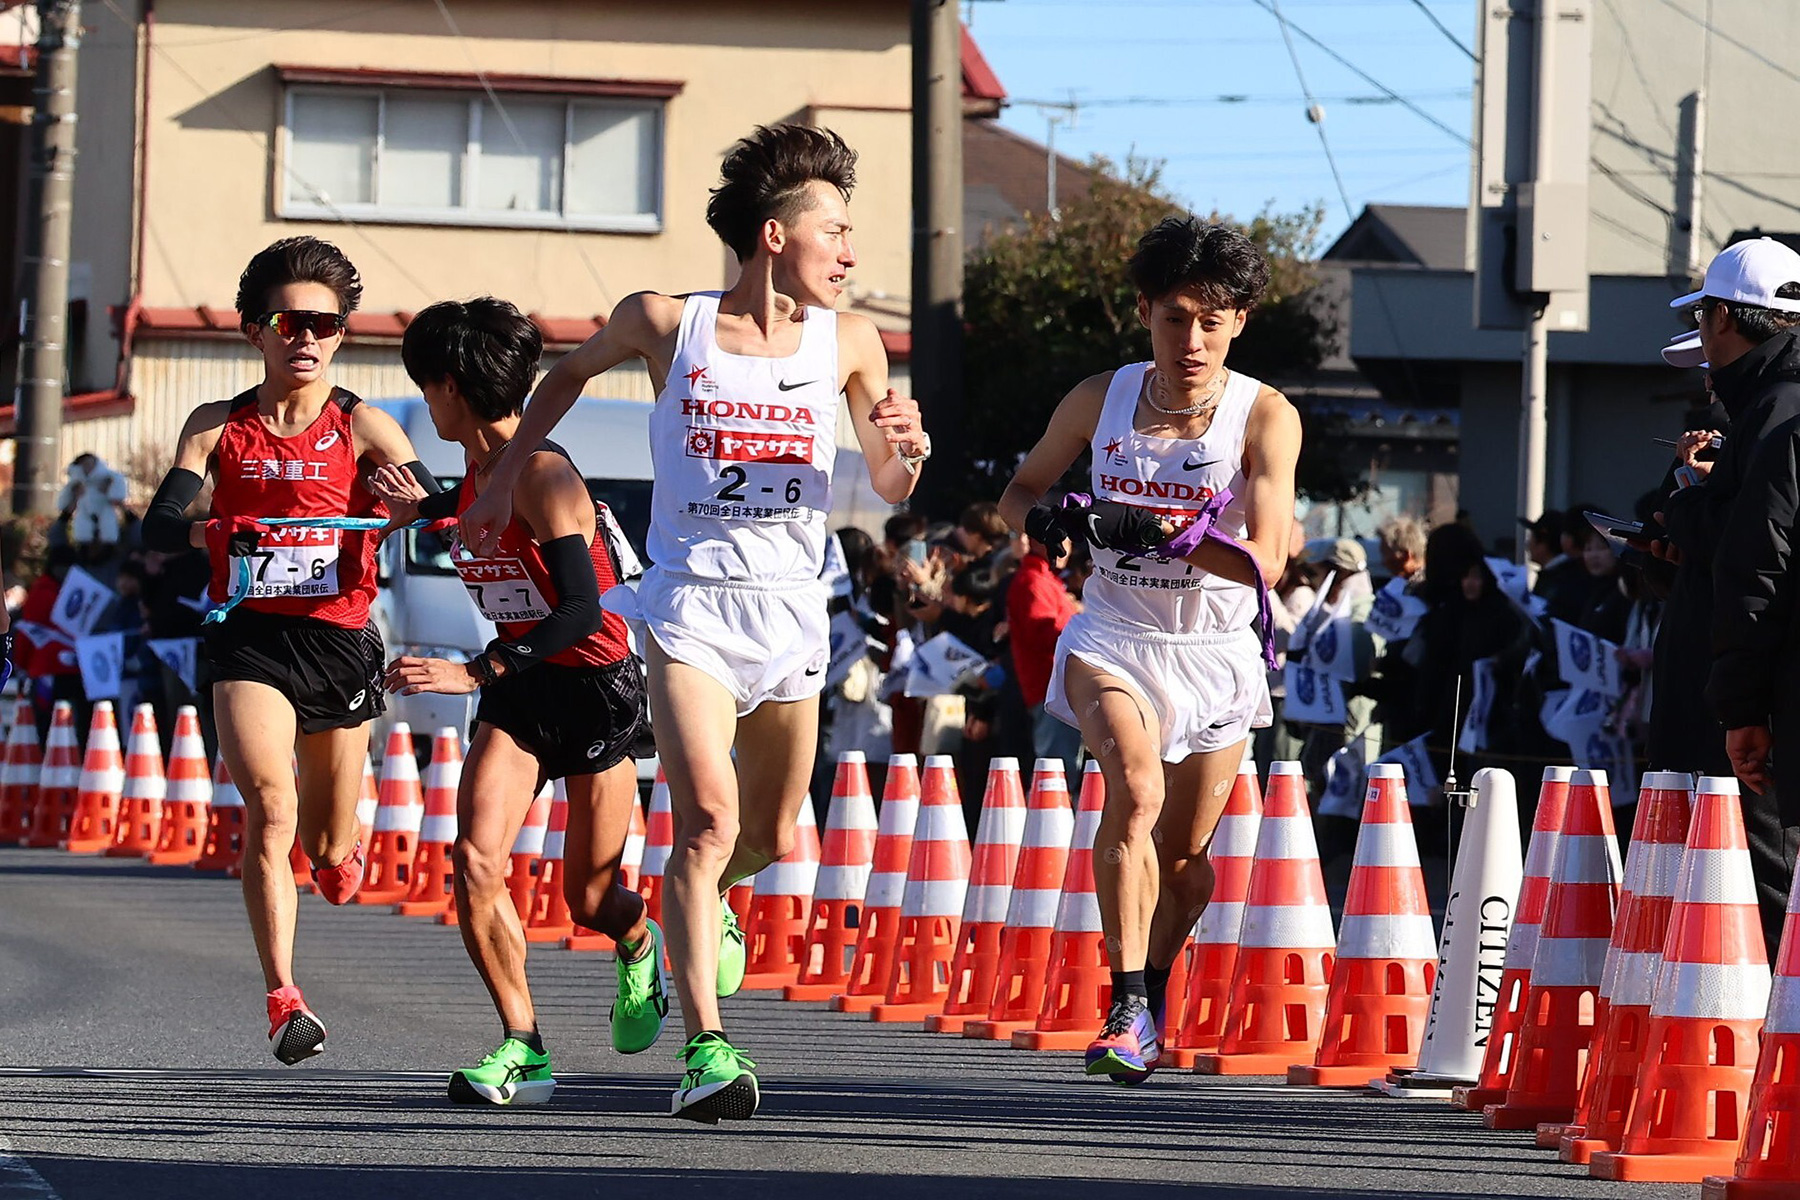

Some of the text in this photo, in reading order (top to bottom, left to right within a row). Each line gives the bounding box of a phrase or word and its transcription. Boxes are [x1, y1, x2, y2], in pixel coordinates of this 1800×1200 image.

[681, 399, 815, 424] HONDA
[721, 436, 808, 457] ヤマザキ
[240, 459, 329, 481] 三菱重工
[717, 465, 747, 501] 2
[785, 478, 802, 504] 6
[1100, 474, 1214, 503] HONDA
[252, 552, 275, 582] 7
[311, 558, 326, 580] 6
[234, 584, 329, 596] 回全日本実業団駅伝
[515, 588, 531, 607] 7
